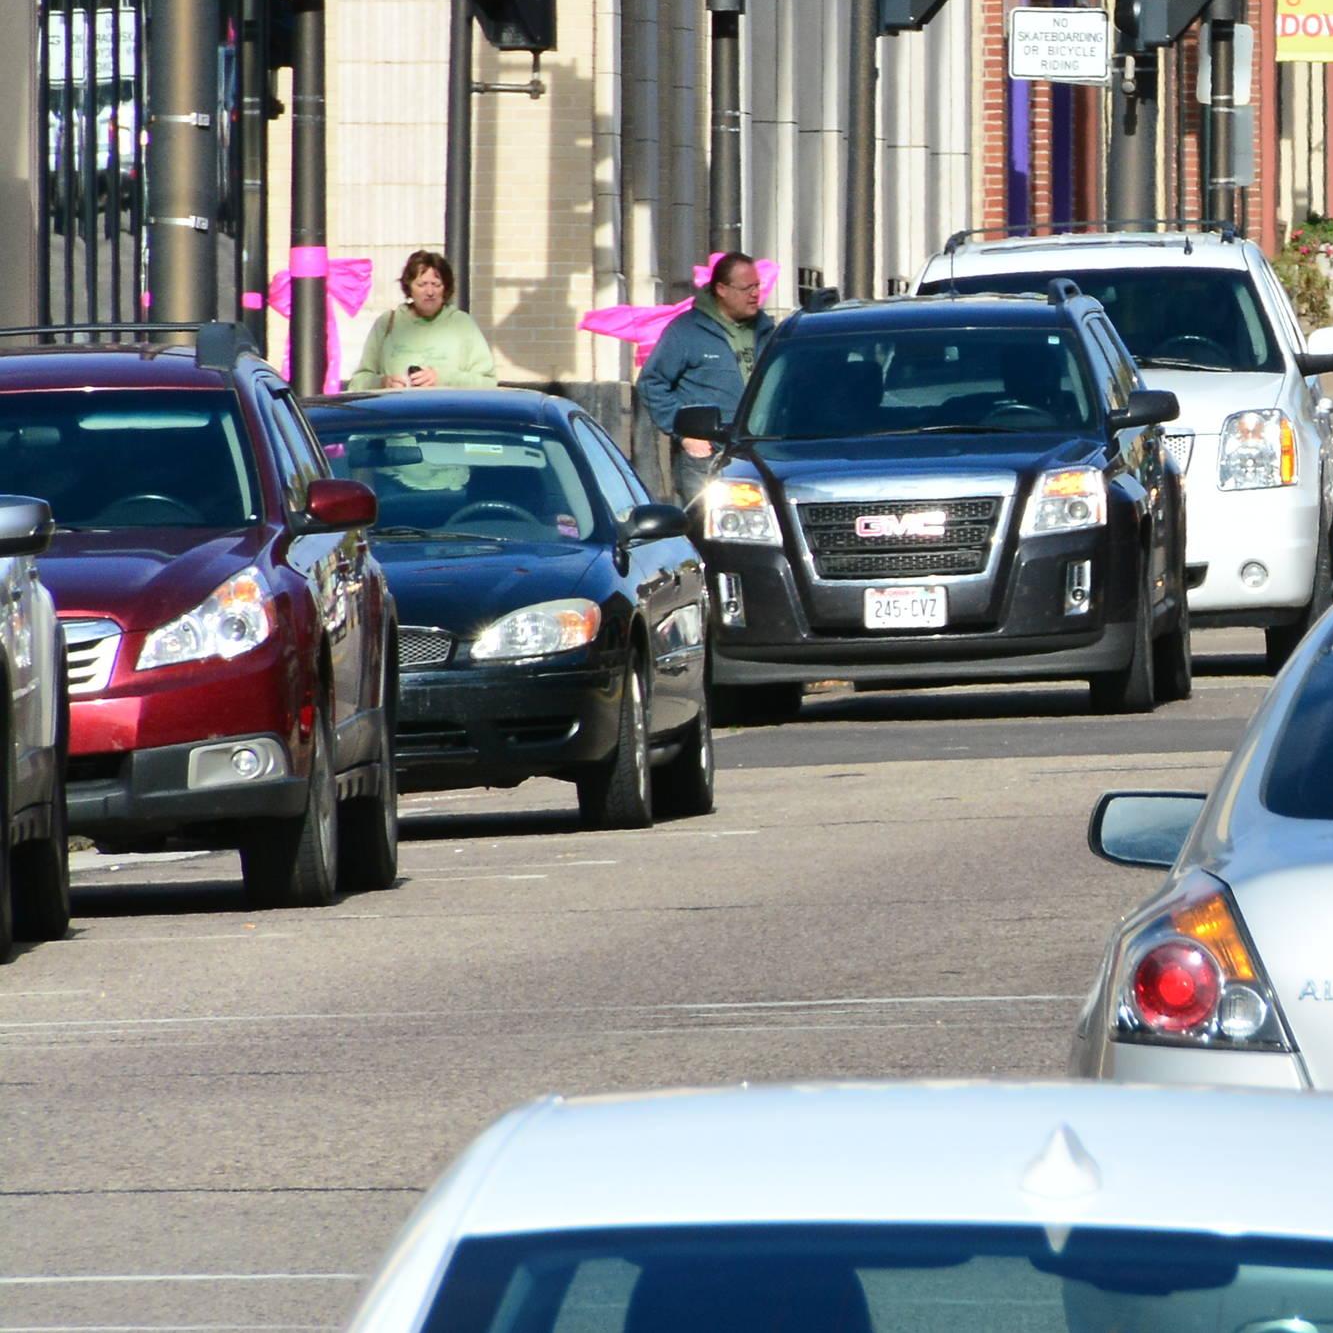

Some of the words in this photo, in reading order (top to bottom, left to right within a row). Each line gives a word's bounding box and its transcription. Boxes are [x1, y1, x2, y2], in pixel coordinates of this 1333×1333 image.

[1052, 18, 1069, 28] NO
[1017, 31, 1104, 43] SKATEBOARDING
[1023, 45, 1040, 56] OR
[1047, 46, 1097, 58] BICYCLE
[1041, 59, 1080, 71] RIDING
[856, 511, 947, 537] GMC
[874, 598, 937, 619] 245-CVZ
